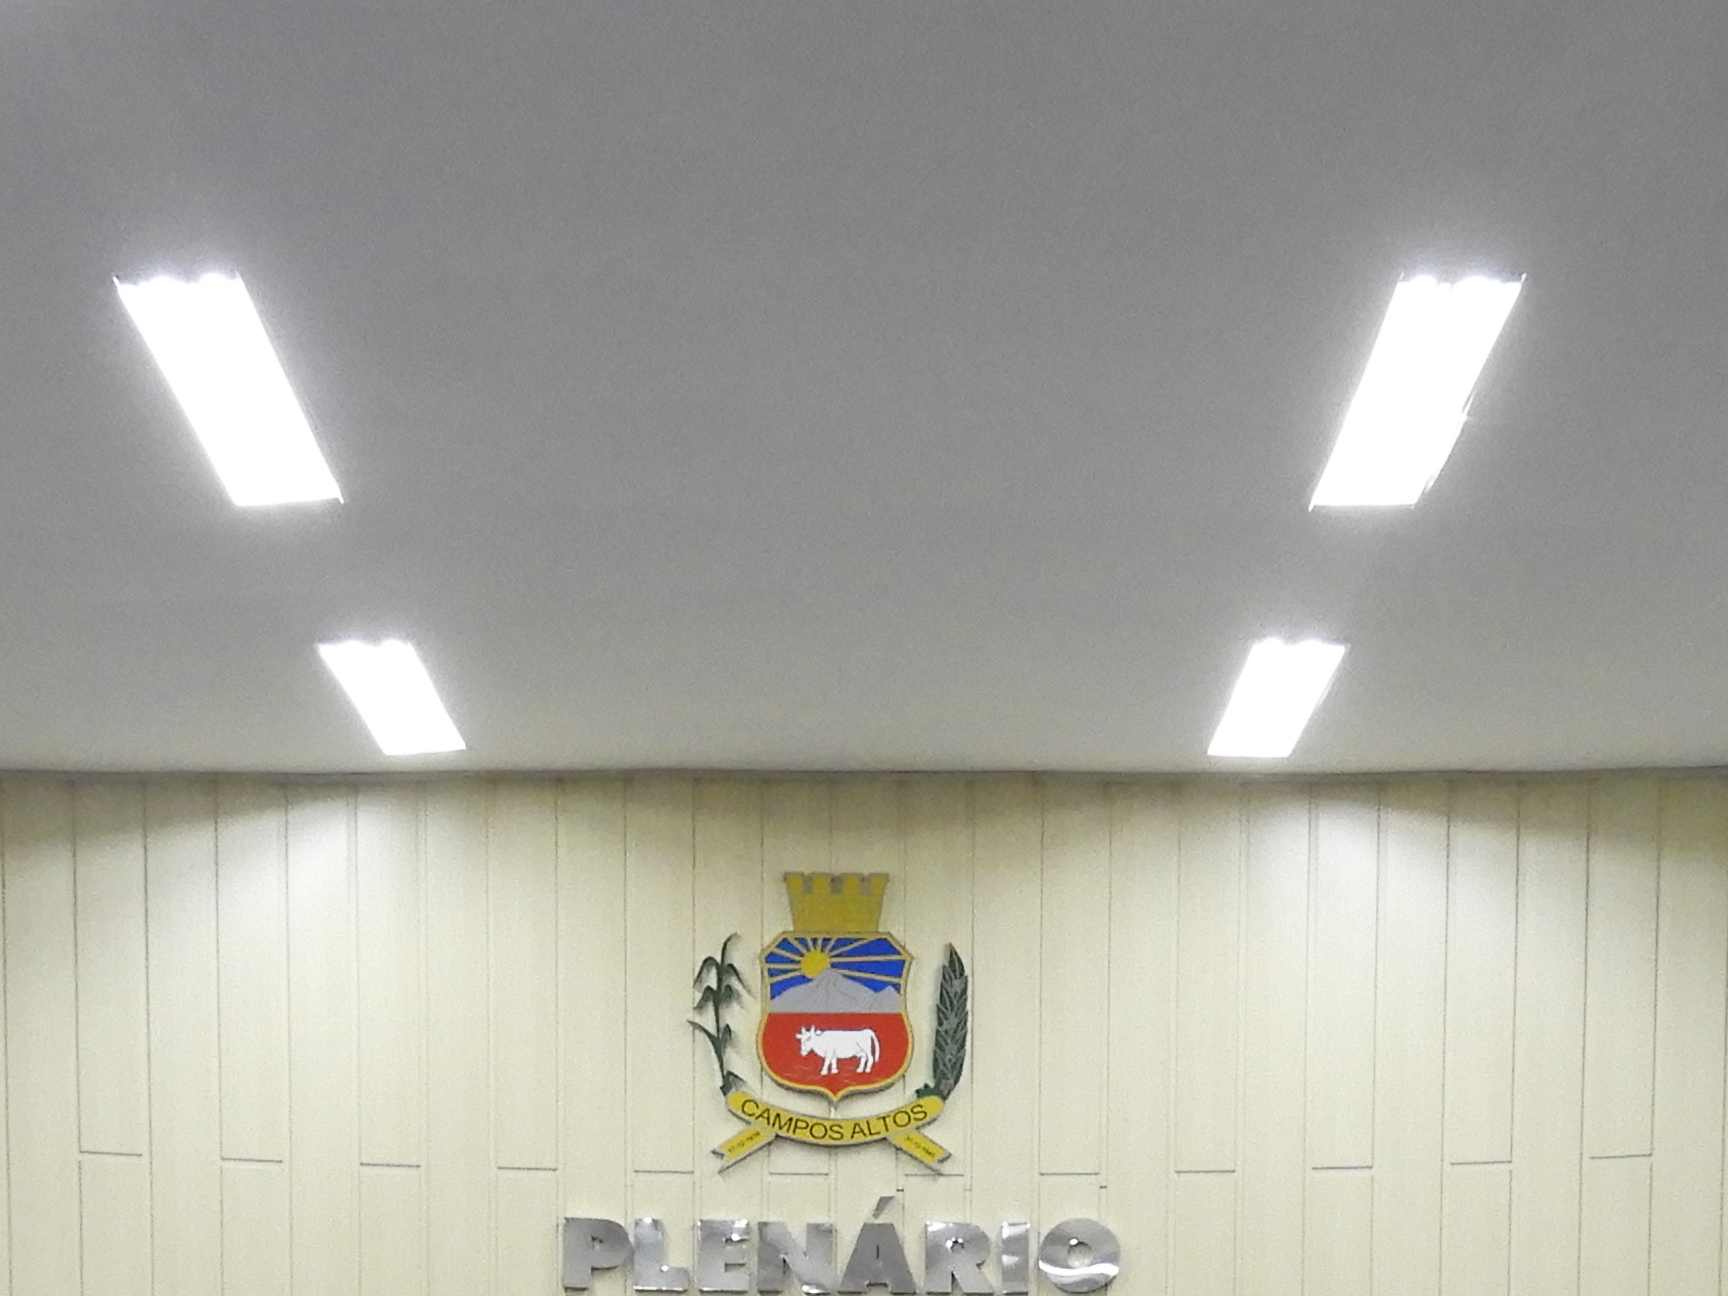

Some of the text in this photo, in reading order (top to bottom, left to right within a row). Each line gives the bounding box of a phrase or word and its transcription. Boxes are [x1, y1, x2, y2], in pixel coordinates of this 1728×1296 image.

[741, 1098, 928, 1141] CAMPOS ALTOS
[561, 1195, 1120, 1296] PLENÁRIO
